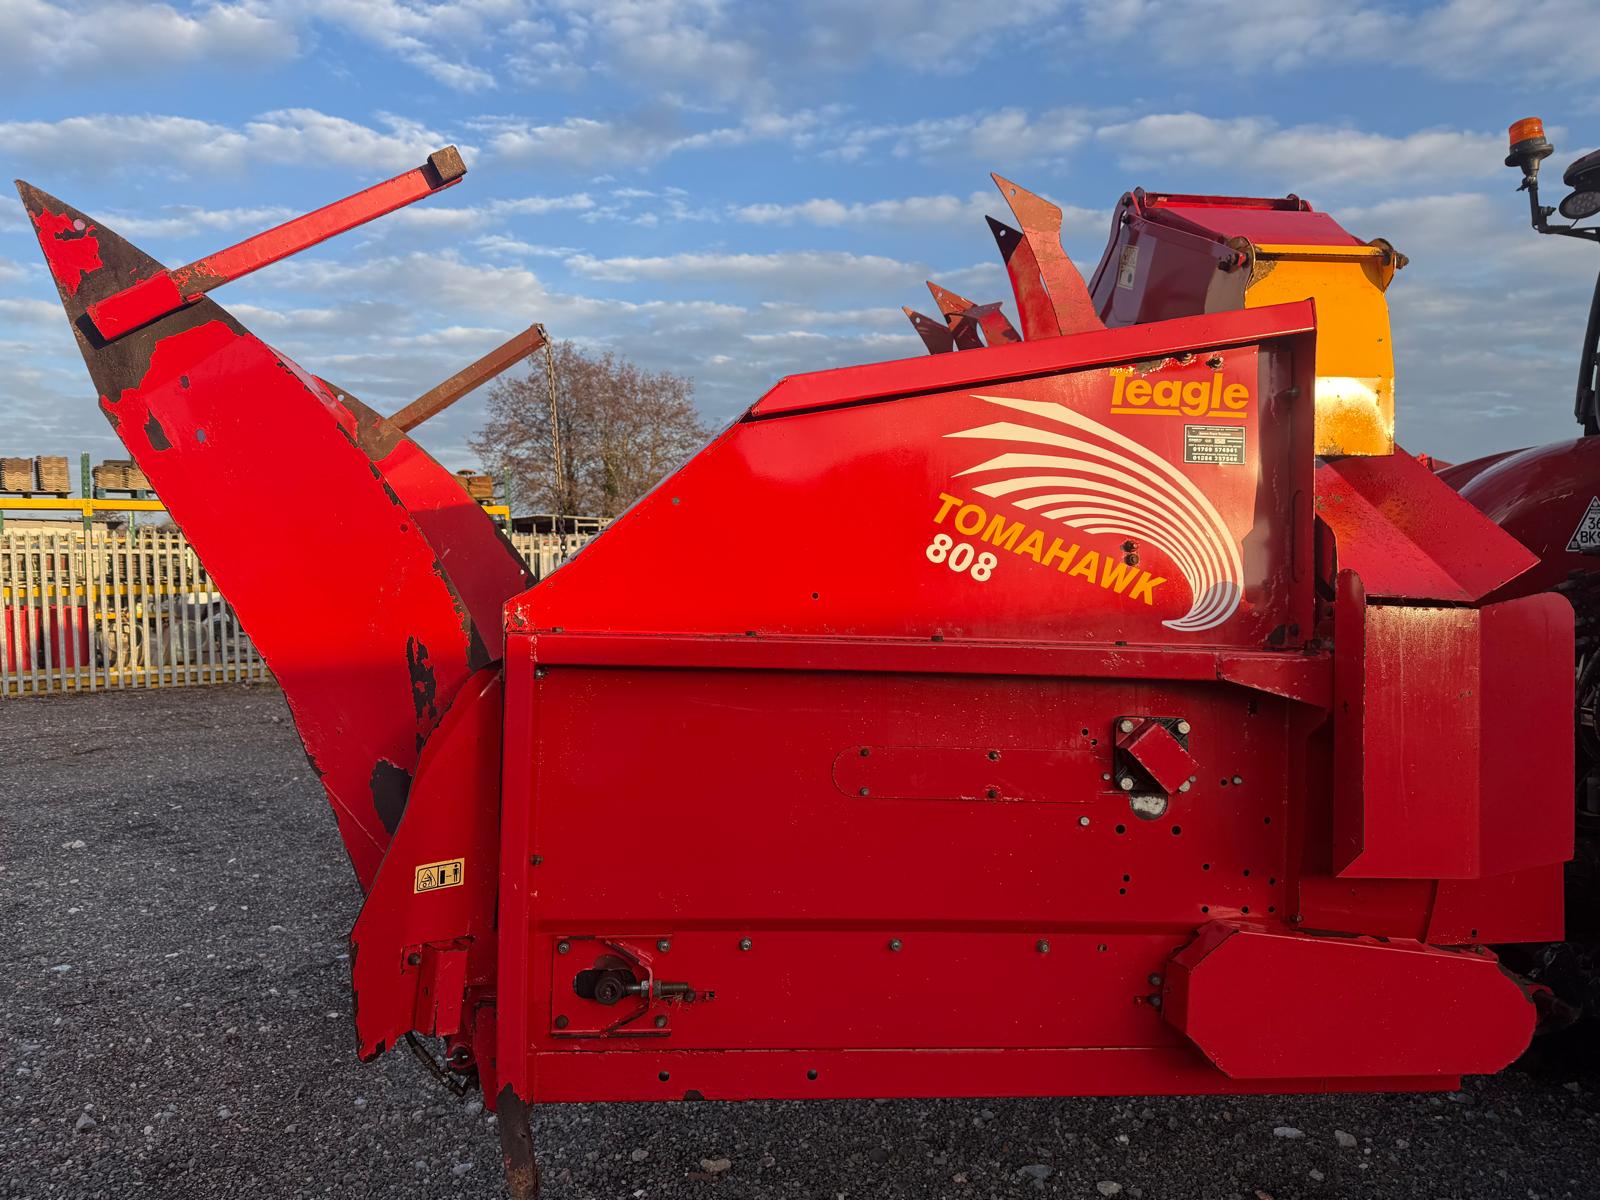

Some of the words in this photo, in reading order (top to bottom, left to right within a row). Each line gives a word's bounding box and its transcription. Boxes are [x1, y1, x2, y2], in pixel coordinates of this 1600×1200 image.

[1109, 368, 1250, 418] Teagle
[925, 533, 998, 582] 808
[933, 492, 1168, 606] TOMAHAWK
